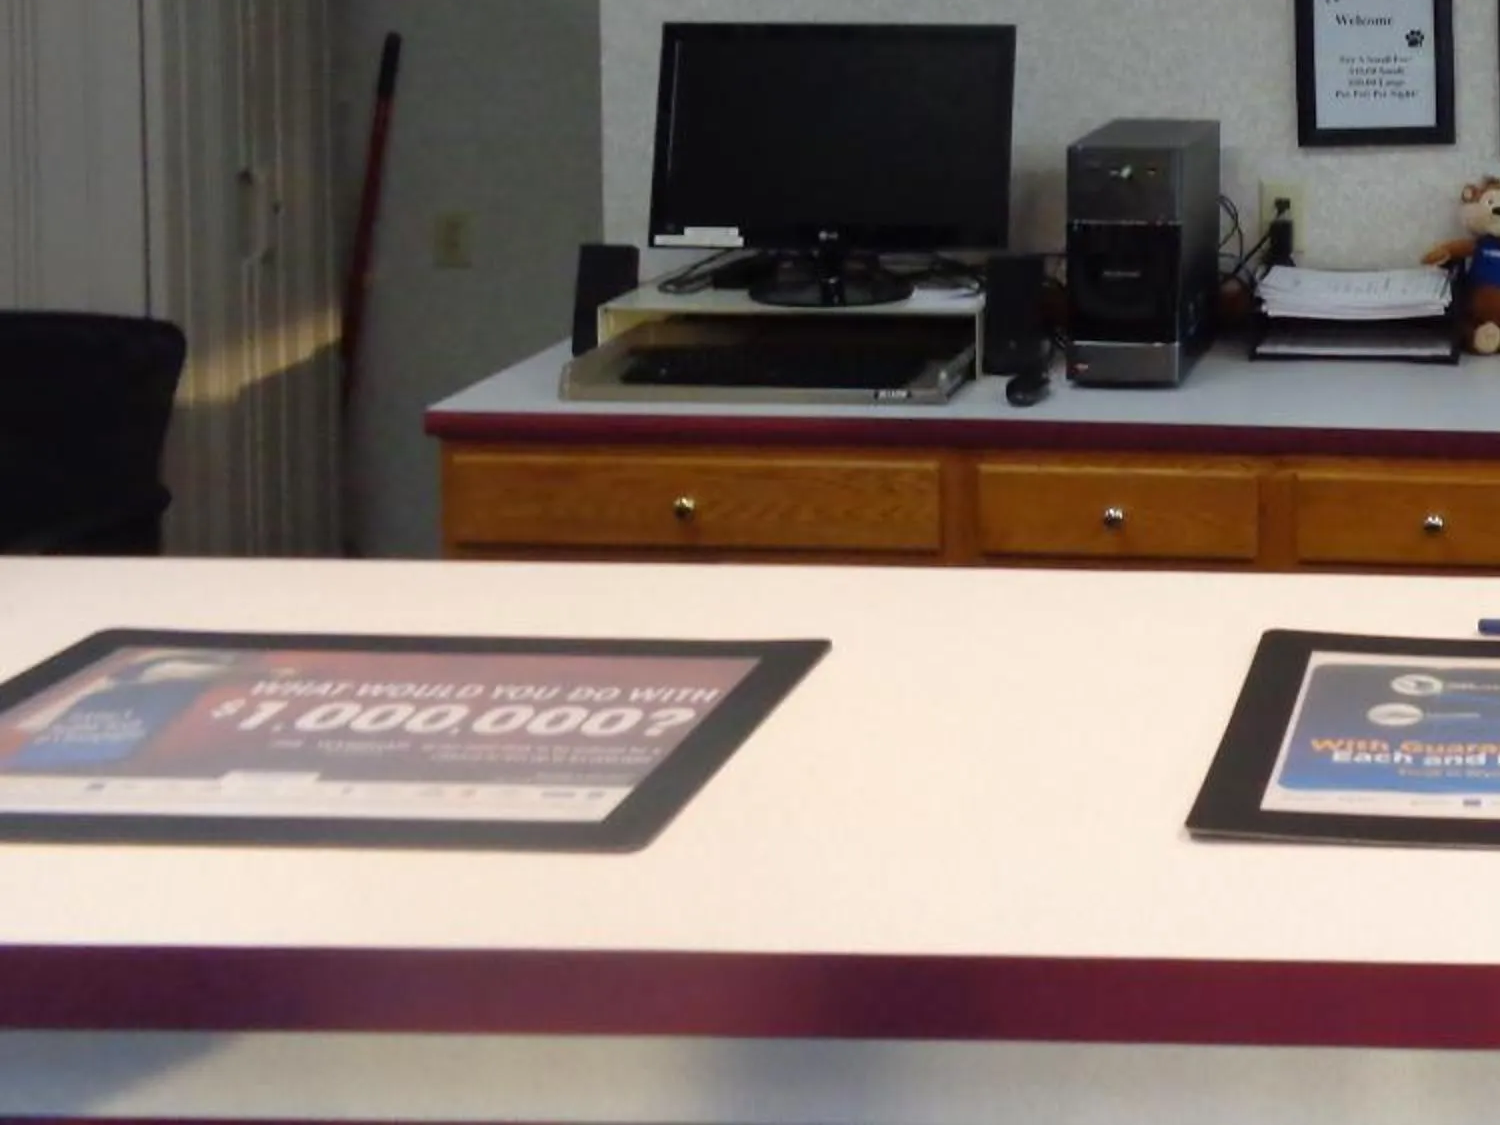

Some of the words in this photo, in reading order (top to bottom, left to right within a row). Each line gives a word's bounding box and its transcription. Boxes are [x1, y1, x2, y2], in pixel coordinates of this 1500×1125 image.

[1335, 13, 1392, 26] Welcome
[250, 679, 351, 697] WHAT
[354, 682, 485, 699] WOULD
[491, 684, 561, 701] YOU
[567, 686, 623, 703] DO
[629, 687, 721, 704] WITH
[1311, 738, 1390, 753] With
[1332, 748, 1414, 765] Each
[1422, 749, 1487, 767] and
